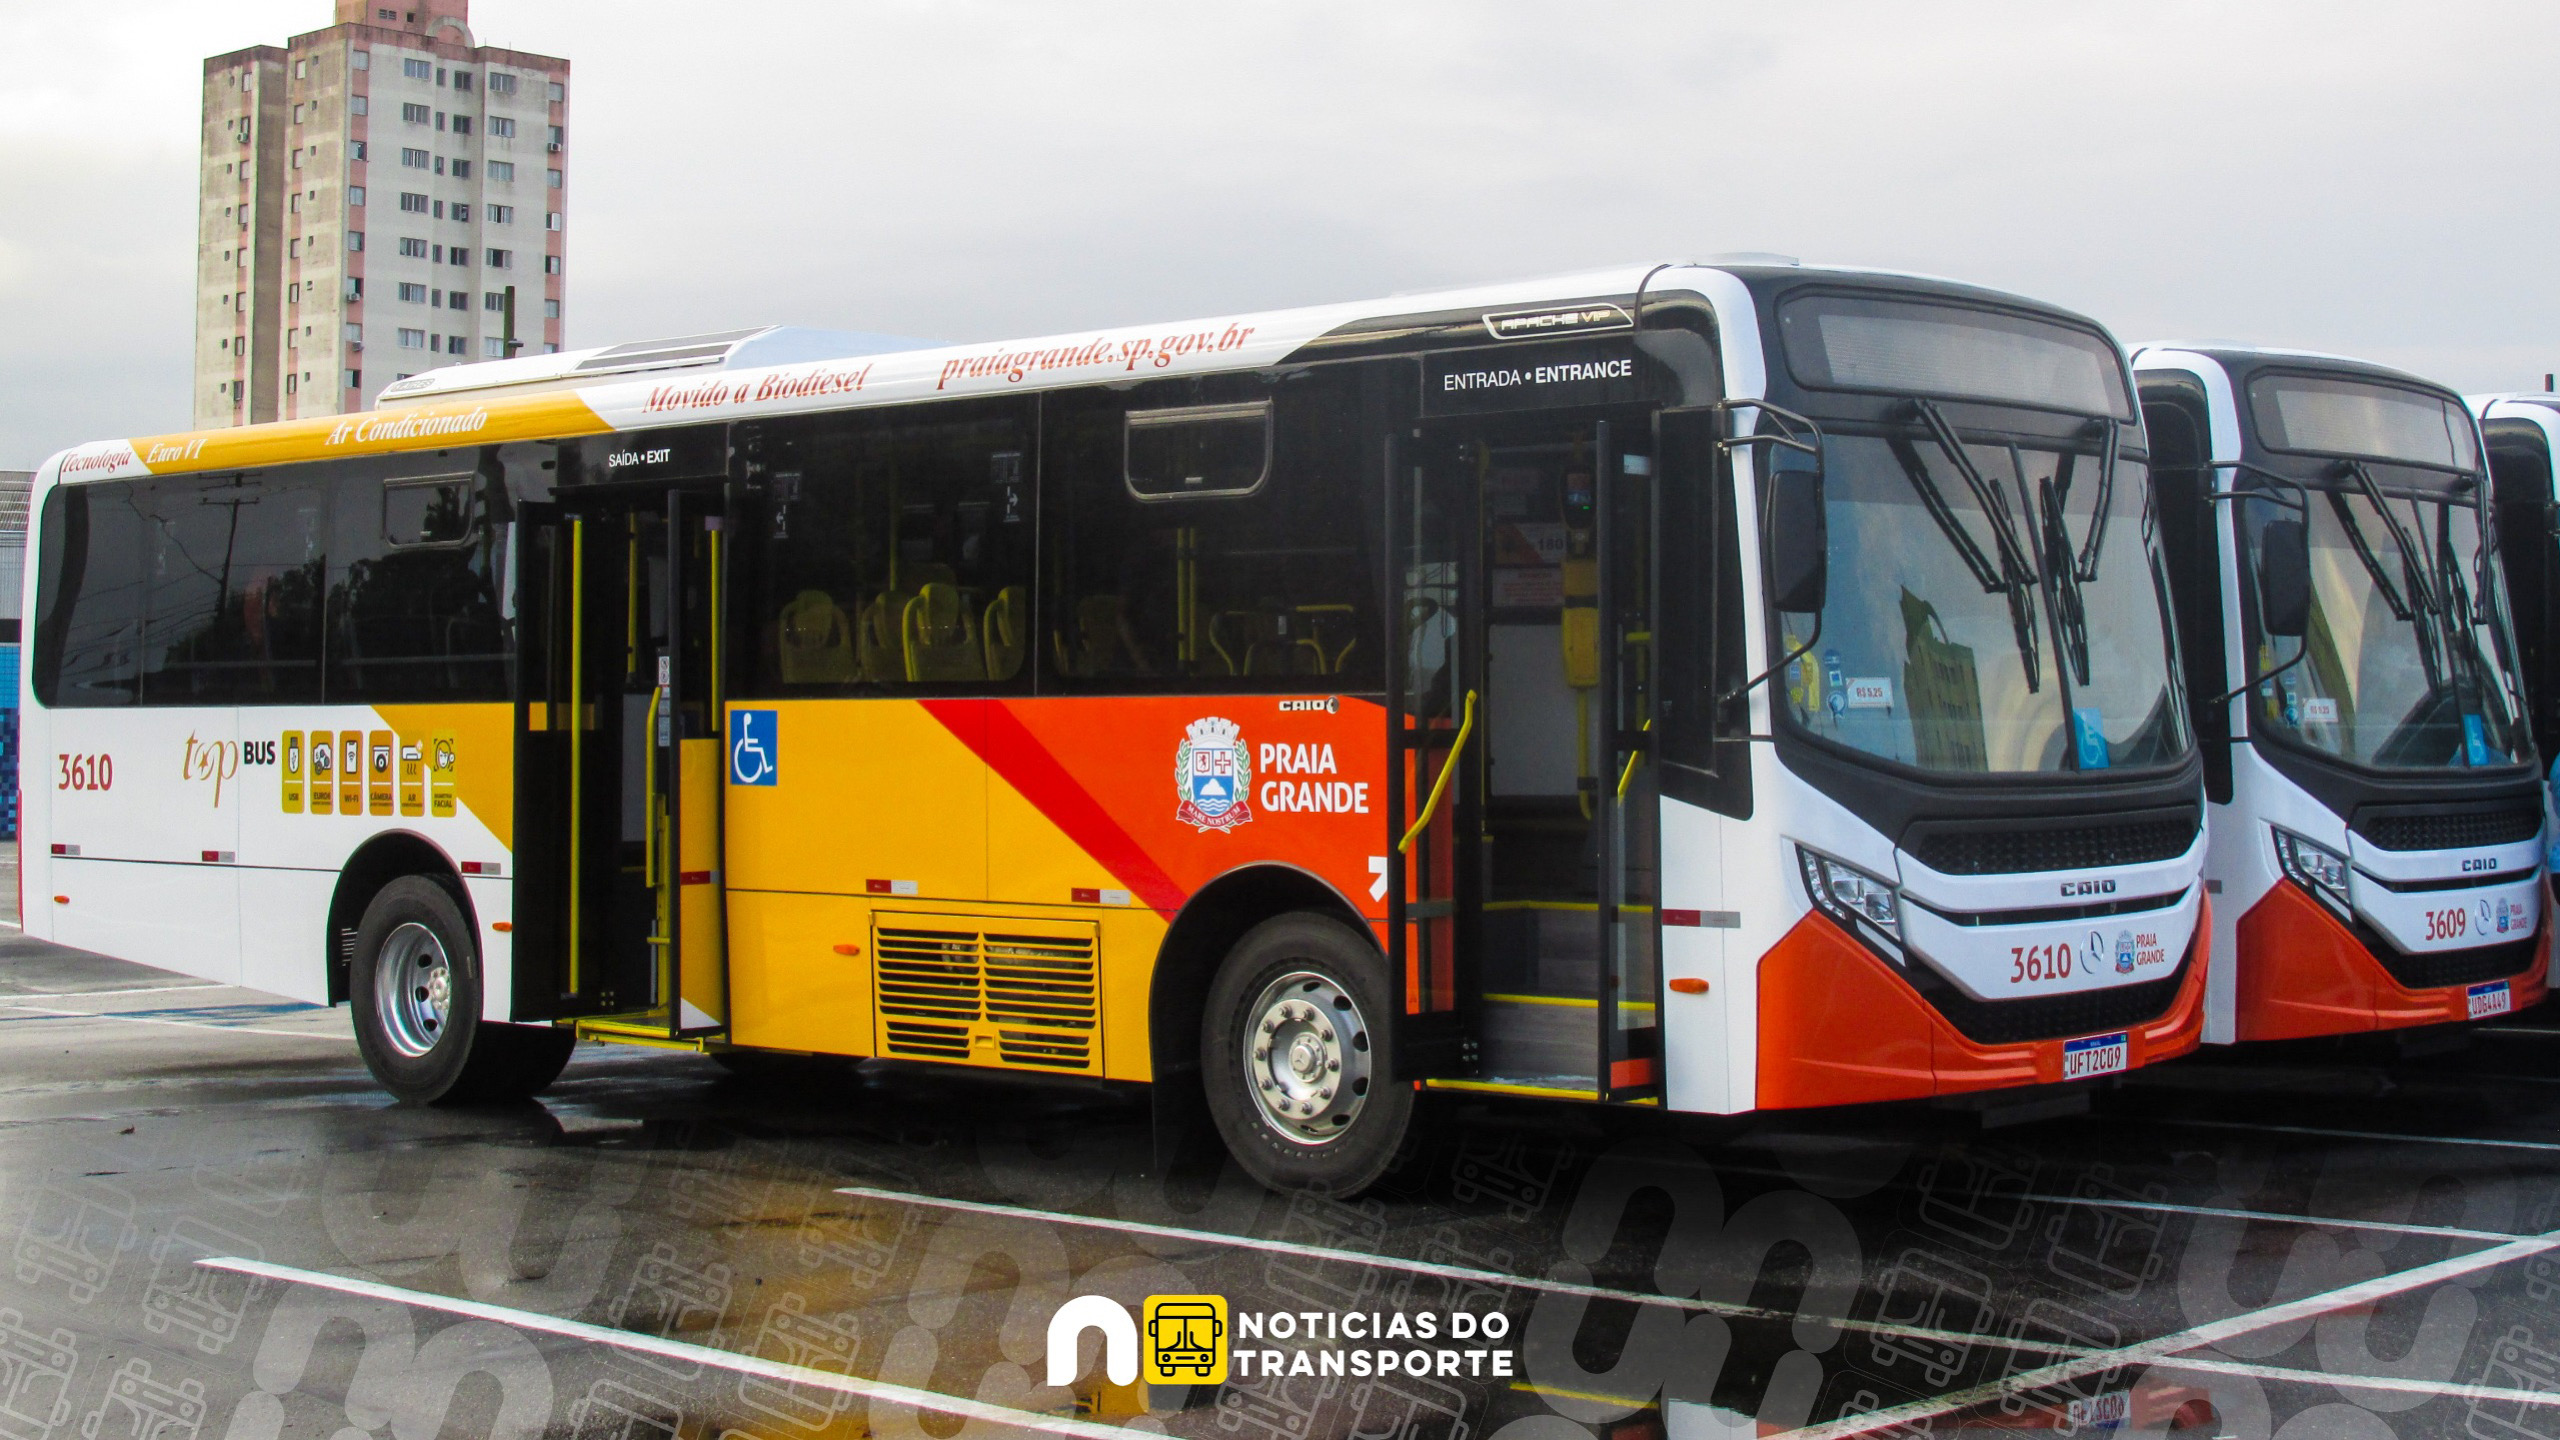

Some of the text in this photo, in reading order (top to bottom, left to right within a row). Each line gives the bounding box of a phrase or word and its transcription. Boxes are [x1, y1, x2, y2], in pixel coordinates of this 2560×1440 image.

[1501, 310, 1611, 330] APACHE VIP
[937, 322, 1255, 390] praiagrande.sp.gov.br
[642, 363, 874, 413] Movido a Biodiesel
[1444, 359, 1632, 391] ENTRADA ENTRANCE
[325, 406, 488, 445] Ar Condicionado
[62, 438, 208, 473] Tecnologia Euro VI
[609, 448, 670, 468] SAÍDA EXIT
[1279, 700, 1327, 711] CAIO
[58, 753, 113, 791] 3610
[183, 729, 275, 808] top BUS
[1260, 743, 1337, 774] PRAIA
[1261, 781, 1369, 814] GRANDE
[1186, 803, 1207, 824] MARE
[2462, 858, 2497, 871] CAIO
[2060, 879, 2116, 897] CAIO
[2425, 908, 2466, 941] 3609
[2136, 933, 2157, 948] PRAIA
[2010, 943, 2071, 984] 3610
[2136, 949, 2164, 965] GRANDE
[2070, 1046, 2121, 1076] UFT2C09
